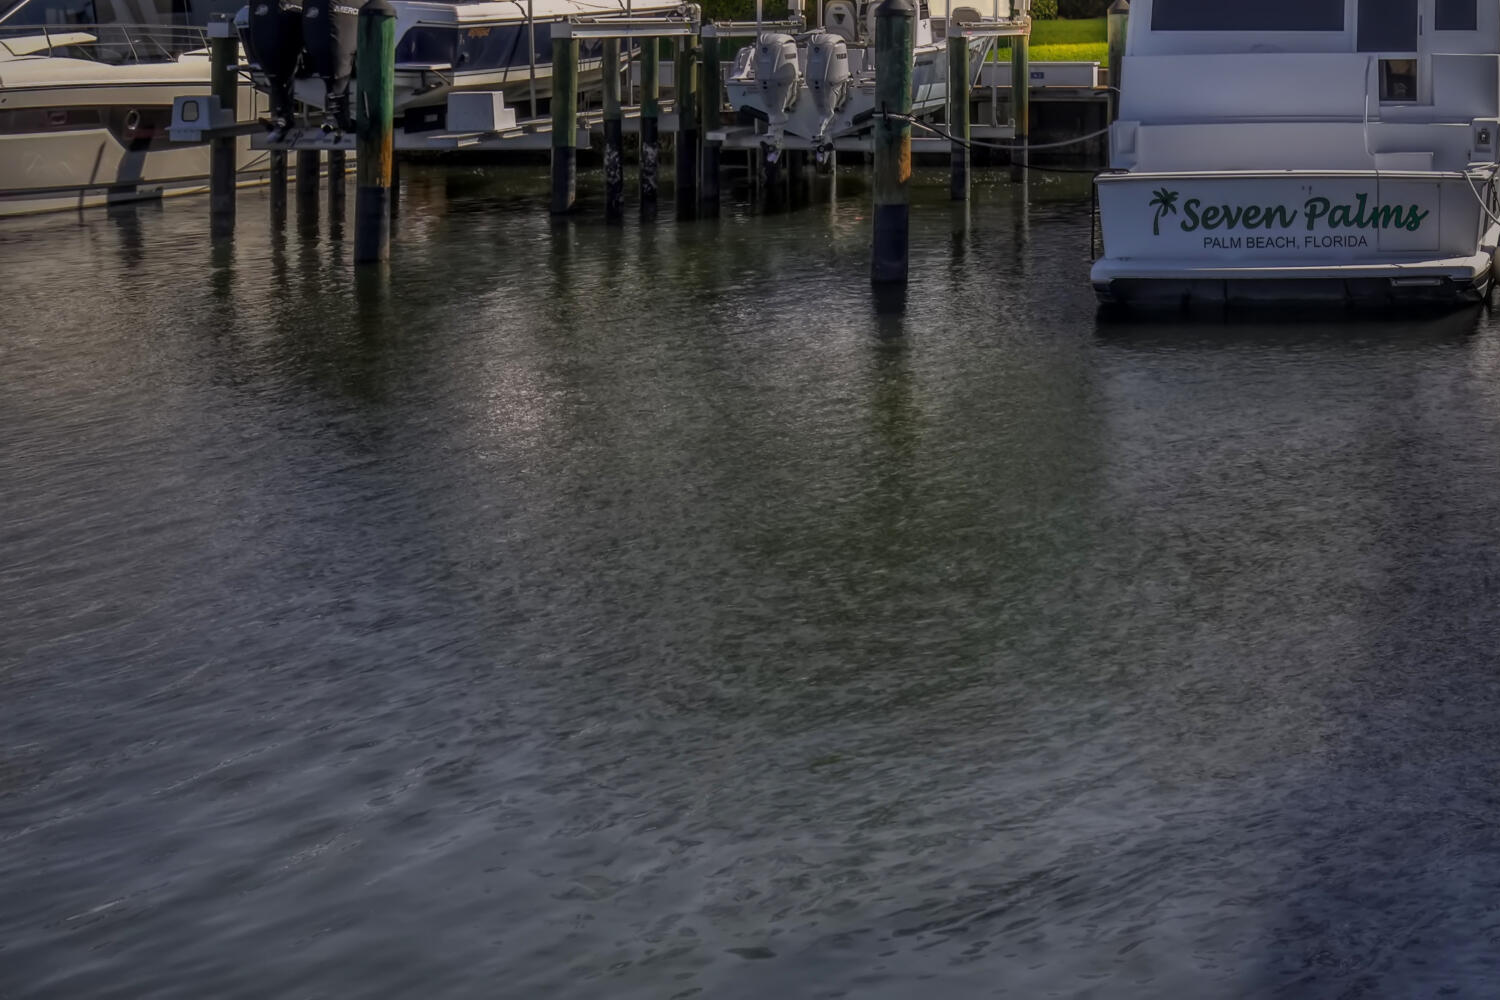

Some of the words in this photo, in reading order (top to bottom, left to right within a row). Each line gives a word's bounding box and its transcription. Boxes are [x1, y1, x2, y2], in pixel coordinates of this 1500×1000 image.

[1180, 199, 1297, 232] Seven
[1305, 193, 1429, 231] Palms
[1203, 237, 1242, 248] PALM
[1247, 237, 1300, 250] BEACH,
[1305, 235, 1368, 248] FLORIDA
